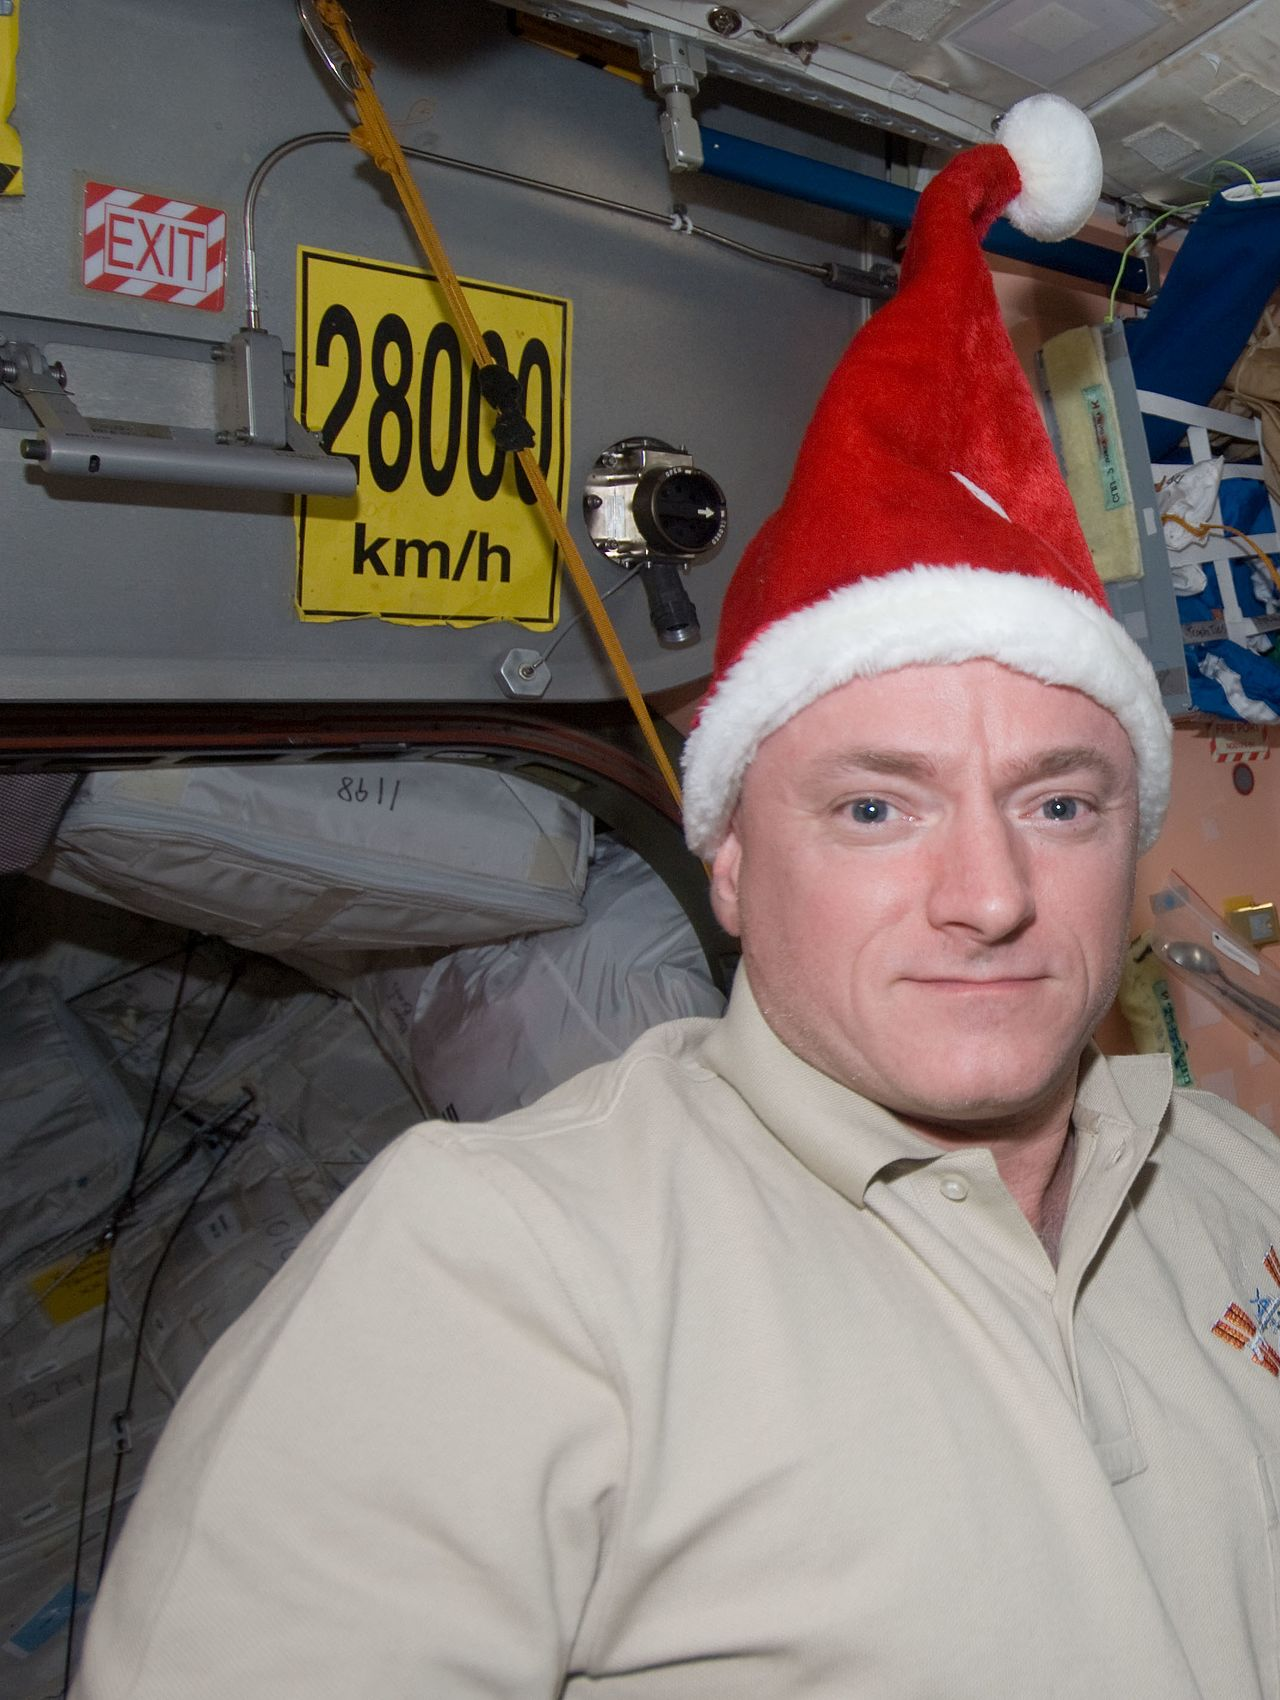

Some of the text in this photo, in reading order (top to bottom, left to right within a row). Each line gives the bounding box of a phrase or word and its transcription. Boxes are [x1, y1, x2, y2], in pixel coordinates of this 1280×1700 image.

[108, 213, 205, 281] EXIT
[315, 304, 552, 506] 28000
[665, 468, 682, 478] OPEN
[353, 521, 511, 583] km/h
